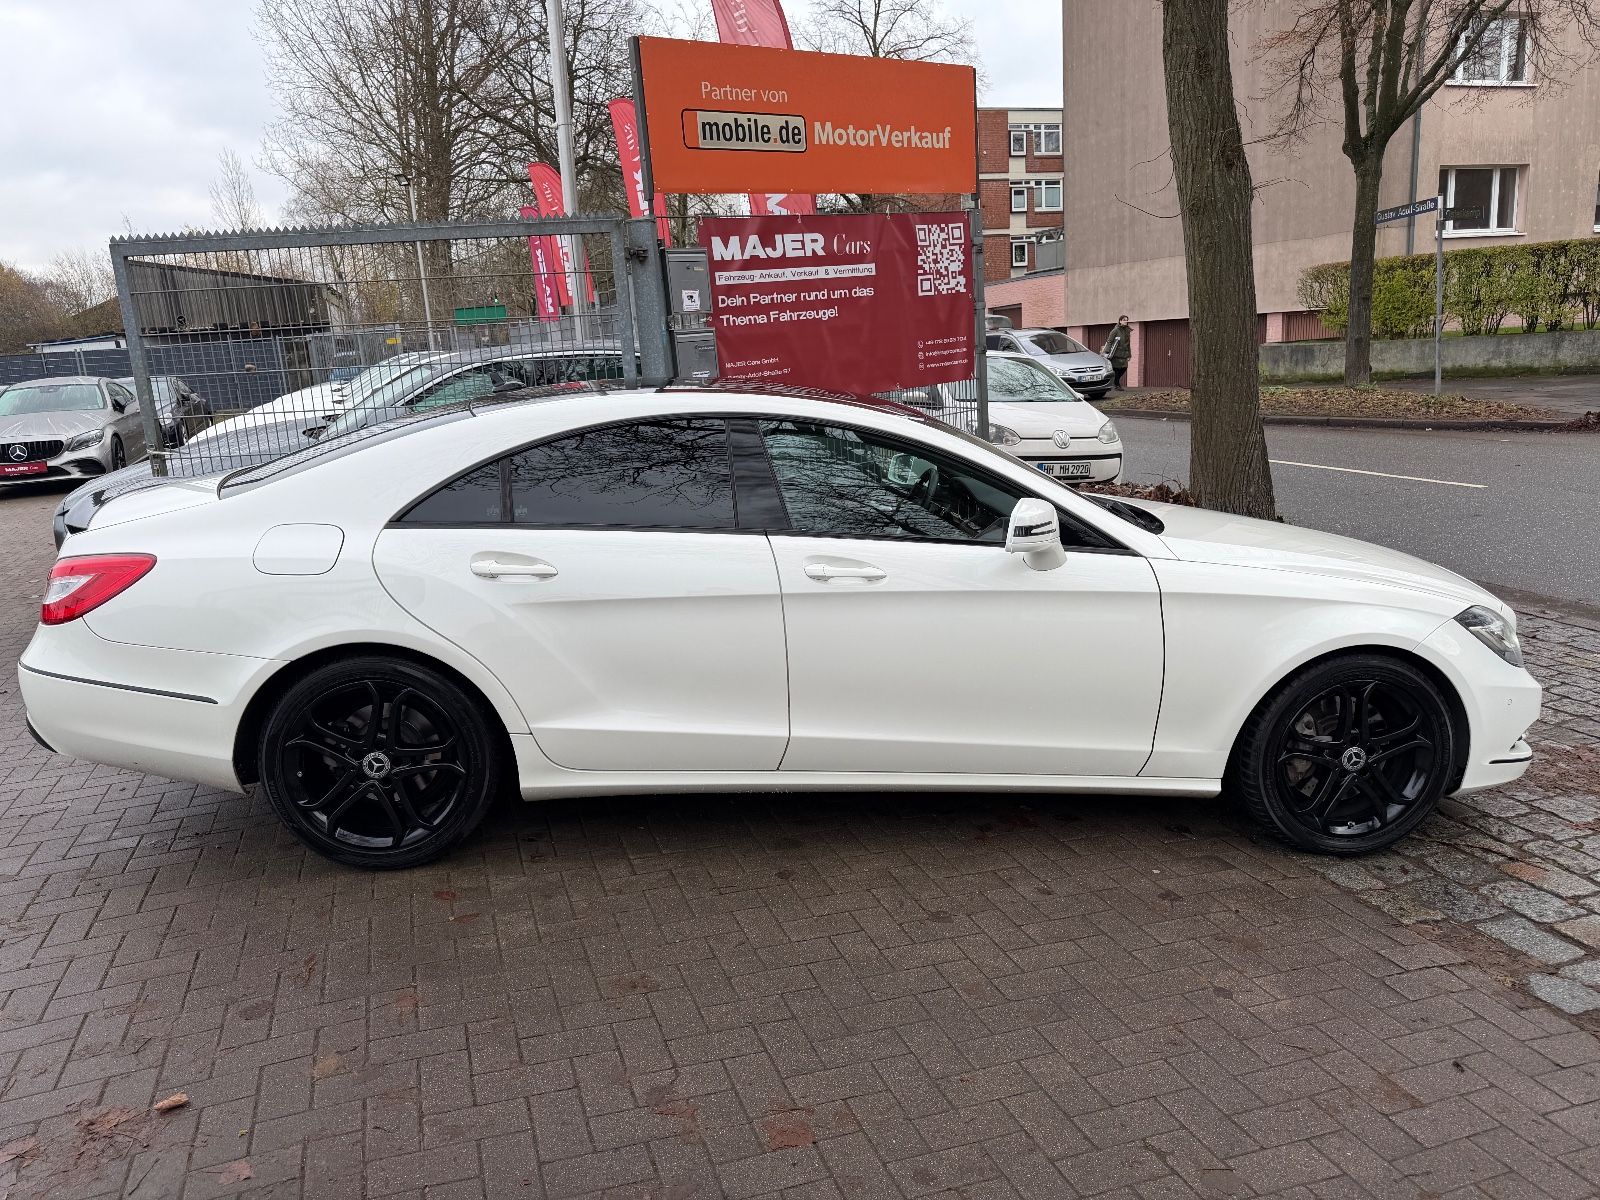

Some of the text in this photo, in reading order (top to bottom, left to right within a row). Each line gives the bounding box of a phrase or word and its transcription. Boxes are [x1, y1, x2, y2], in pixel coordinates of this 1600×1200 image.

[701, 81, 788, 103] Partner von
[701, 118, 951, 149] mobile.de MotorVerkauf
[711, 233, 871, 261] MAJER Cars
[790, 268, 819, 278] Verkauf
[833, 265, 873, 276] Vermittlung
[718, 286, 874, 308] Dein Partner rund um das
[720, 306, 839, 327] Thema Fahrzeuge!
[1043, 463, 1089, 475] HH MH 2920
